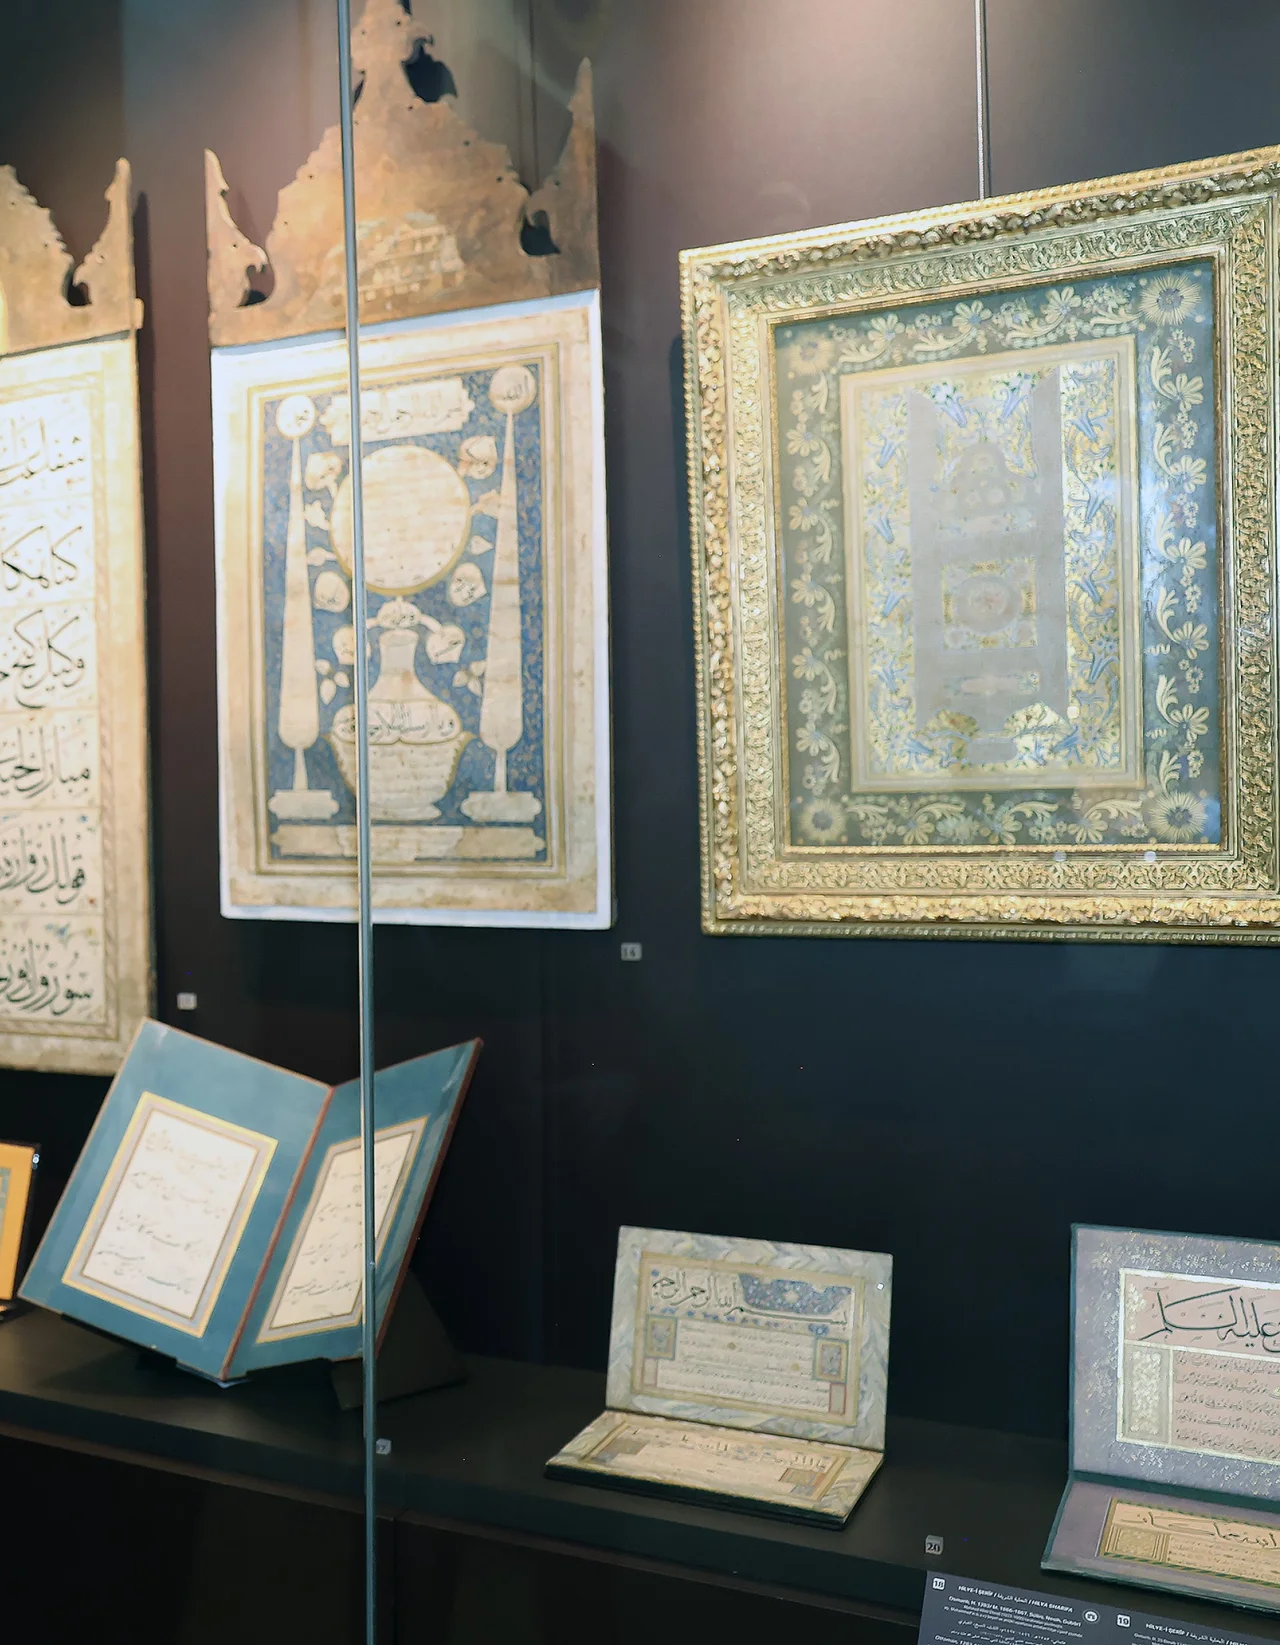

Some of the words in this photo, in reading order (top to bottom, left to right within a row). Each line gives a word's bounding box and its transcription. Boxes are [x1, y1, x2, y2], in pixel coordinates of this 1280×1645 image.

[926, 1542, 941, 1553] 20
[933, 1579, 945, 1589] 18
[1118, 1617, 1129, 1625] 19
